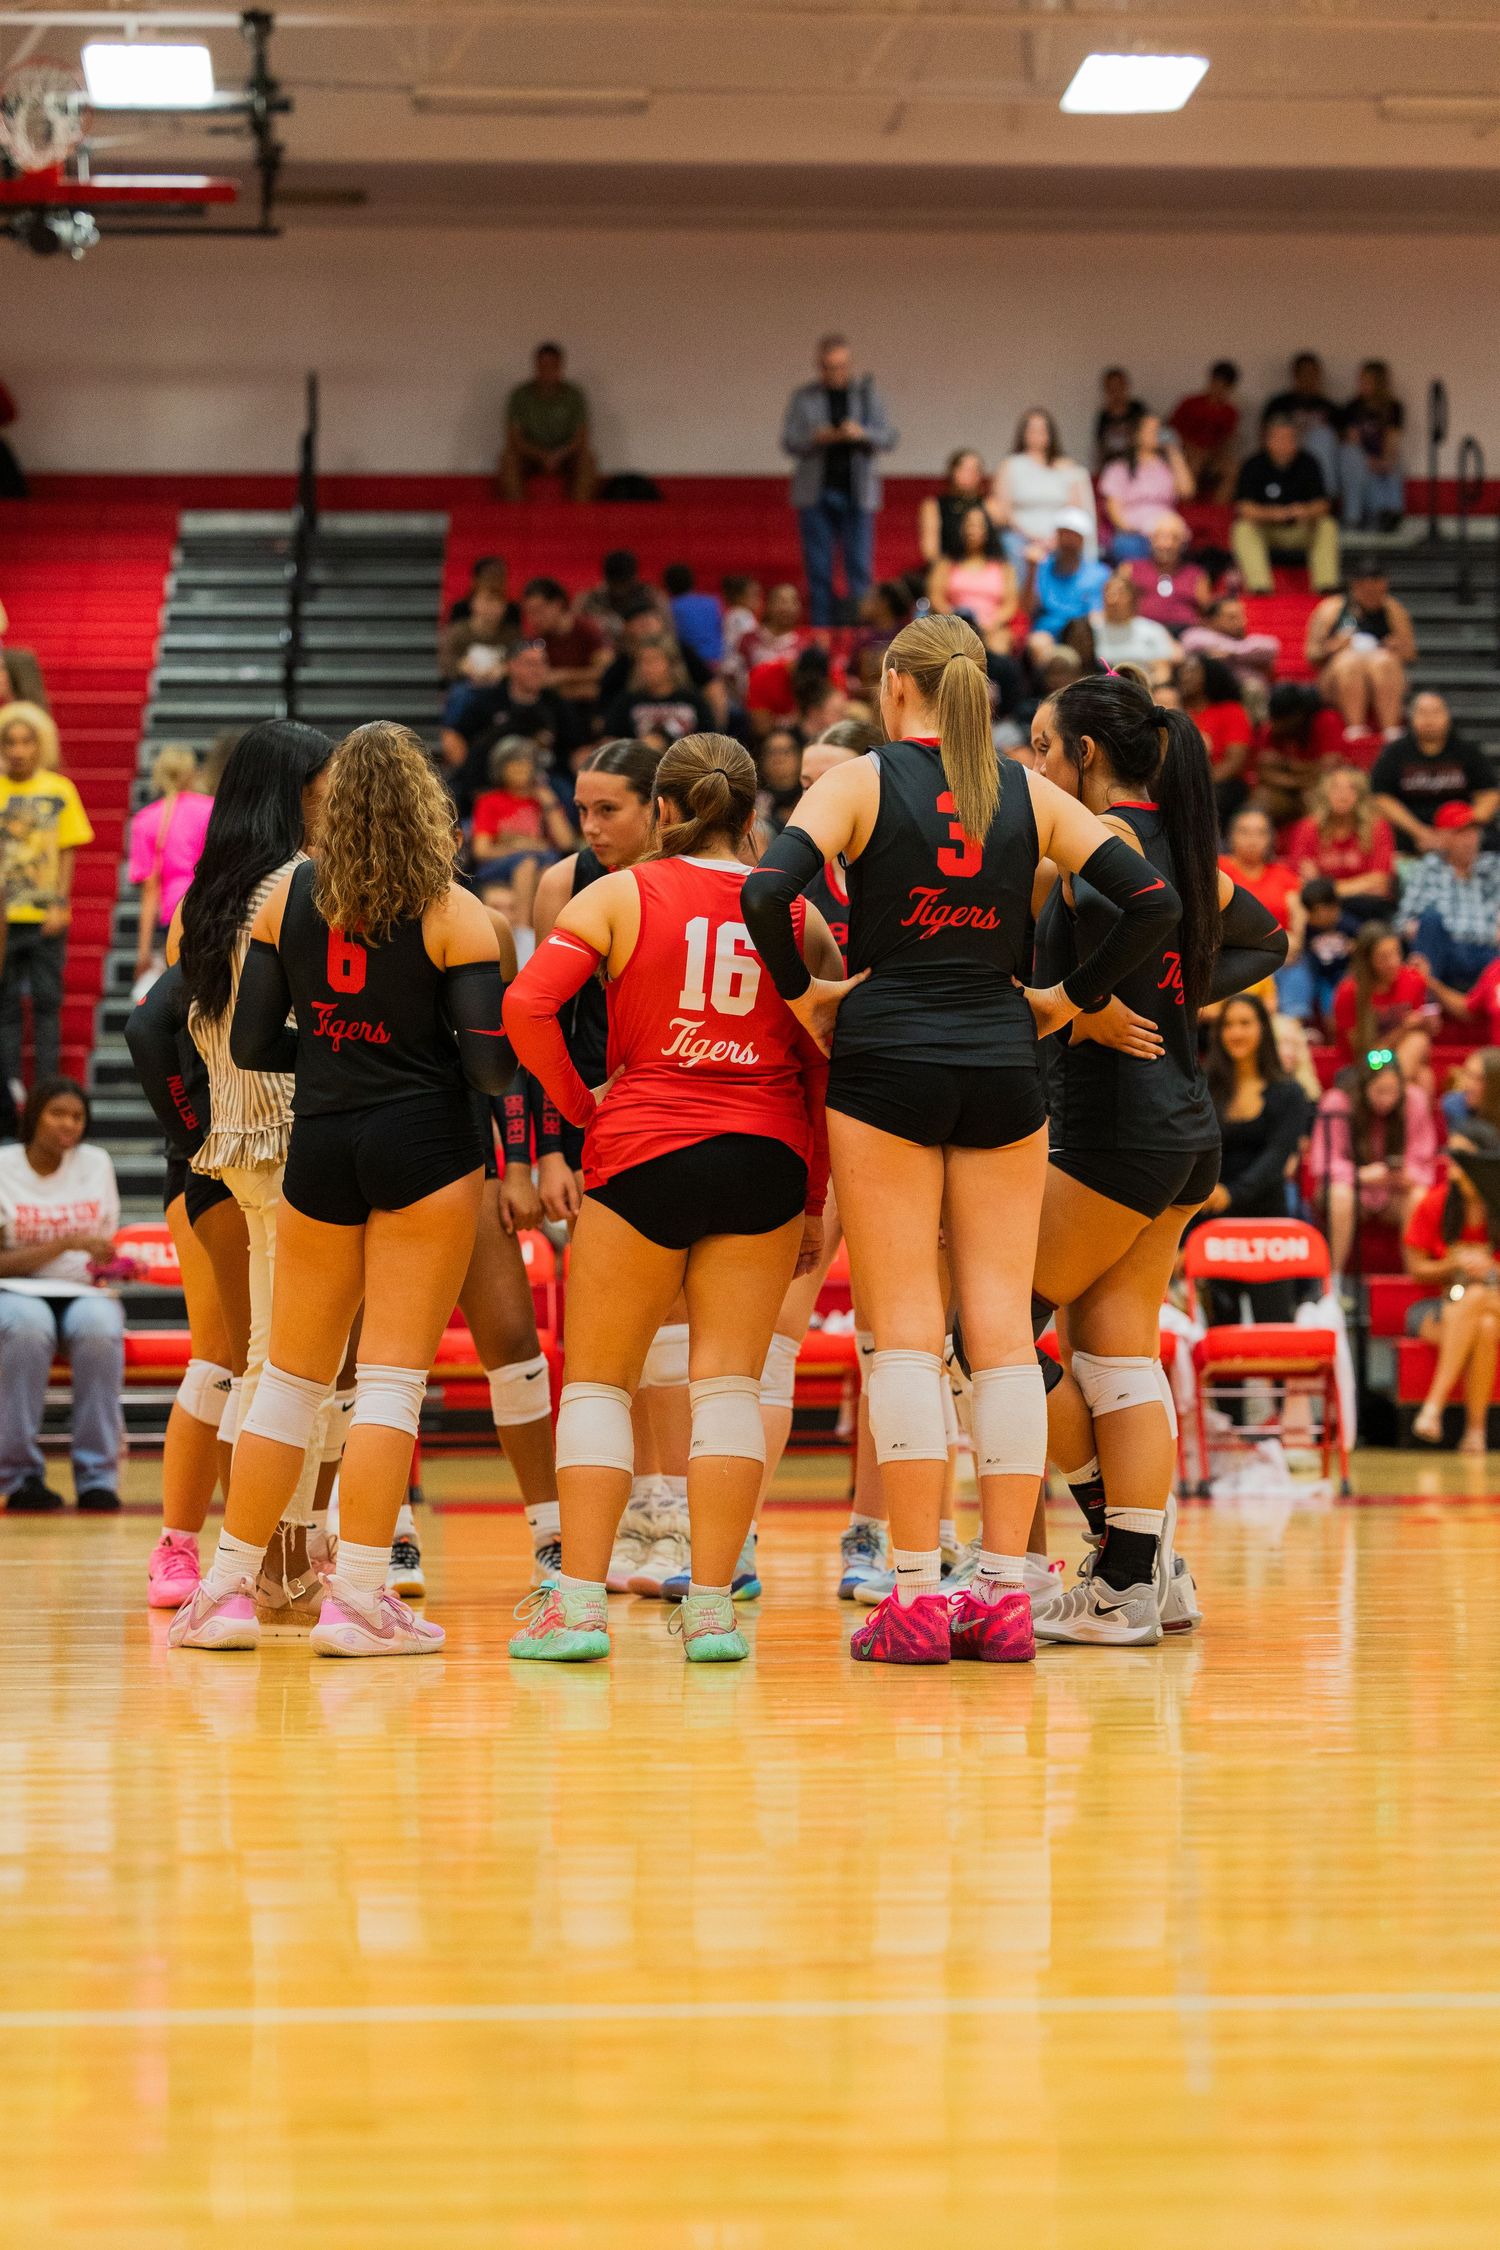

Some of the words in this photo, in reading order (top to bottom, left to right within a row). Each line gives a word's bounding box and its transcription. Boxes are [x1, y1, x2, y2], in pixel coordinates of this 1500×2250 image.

[936, 791, 983, 878] 3
[900, 886, 1001, 940] Tigers
[327, 919, 367, 994] 6
[678, 916, 762, 1017] 16
[310, 1001, 391, 1052] Tigers
[661, 1017, 760, 1068] Tigers
[1203, 1236, 1310, 1262] BELTON
[1004, 1606, 1026, 1622] TWELVE
